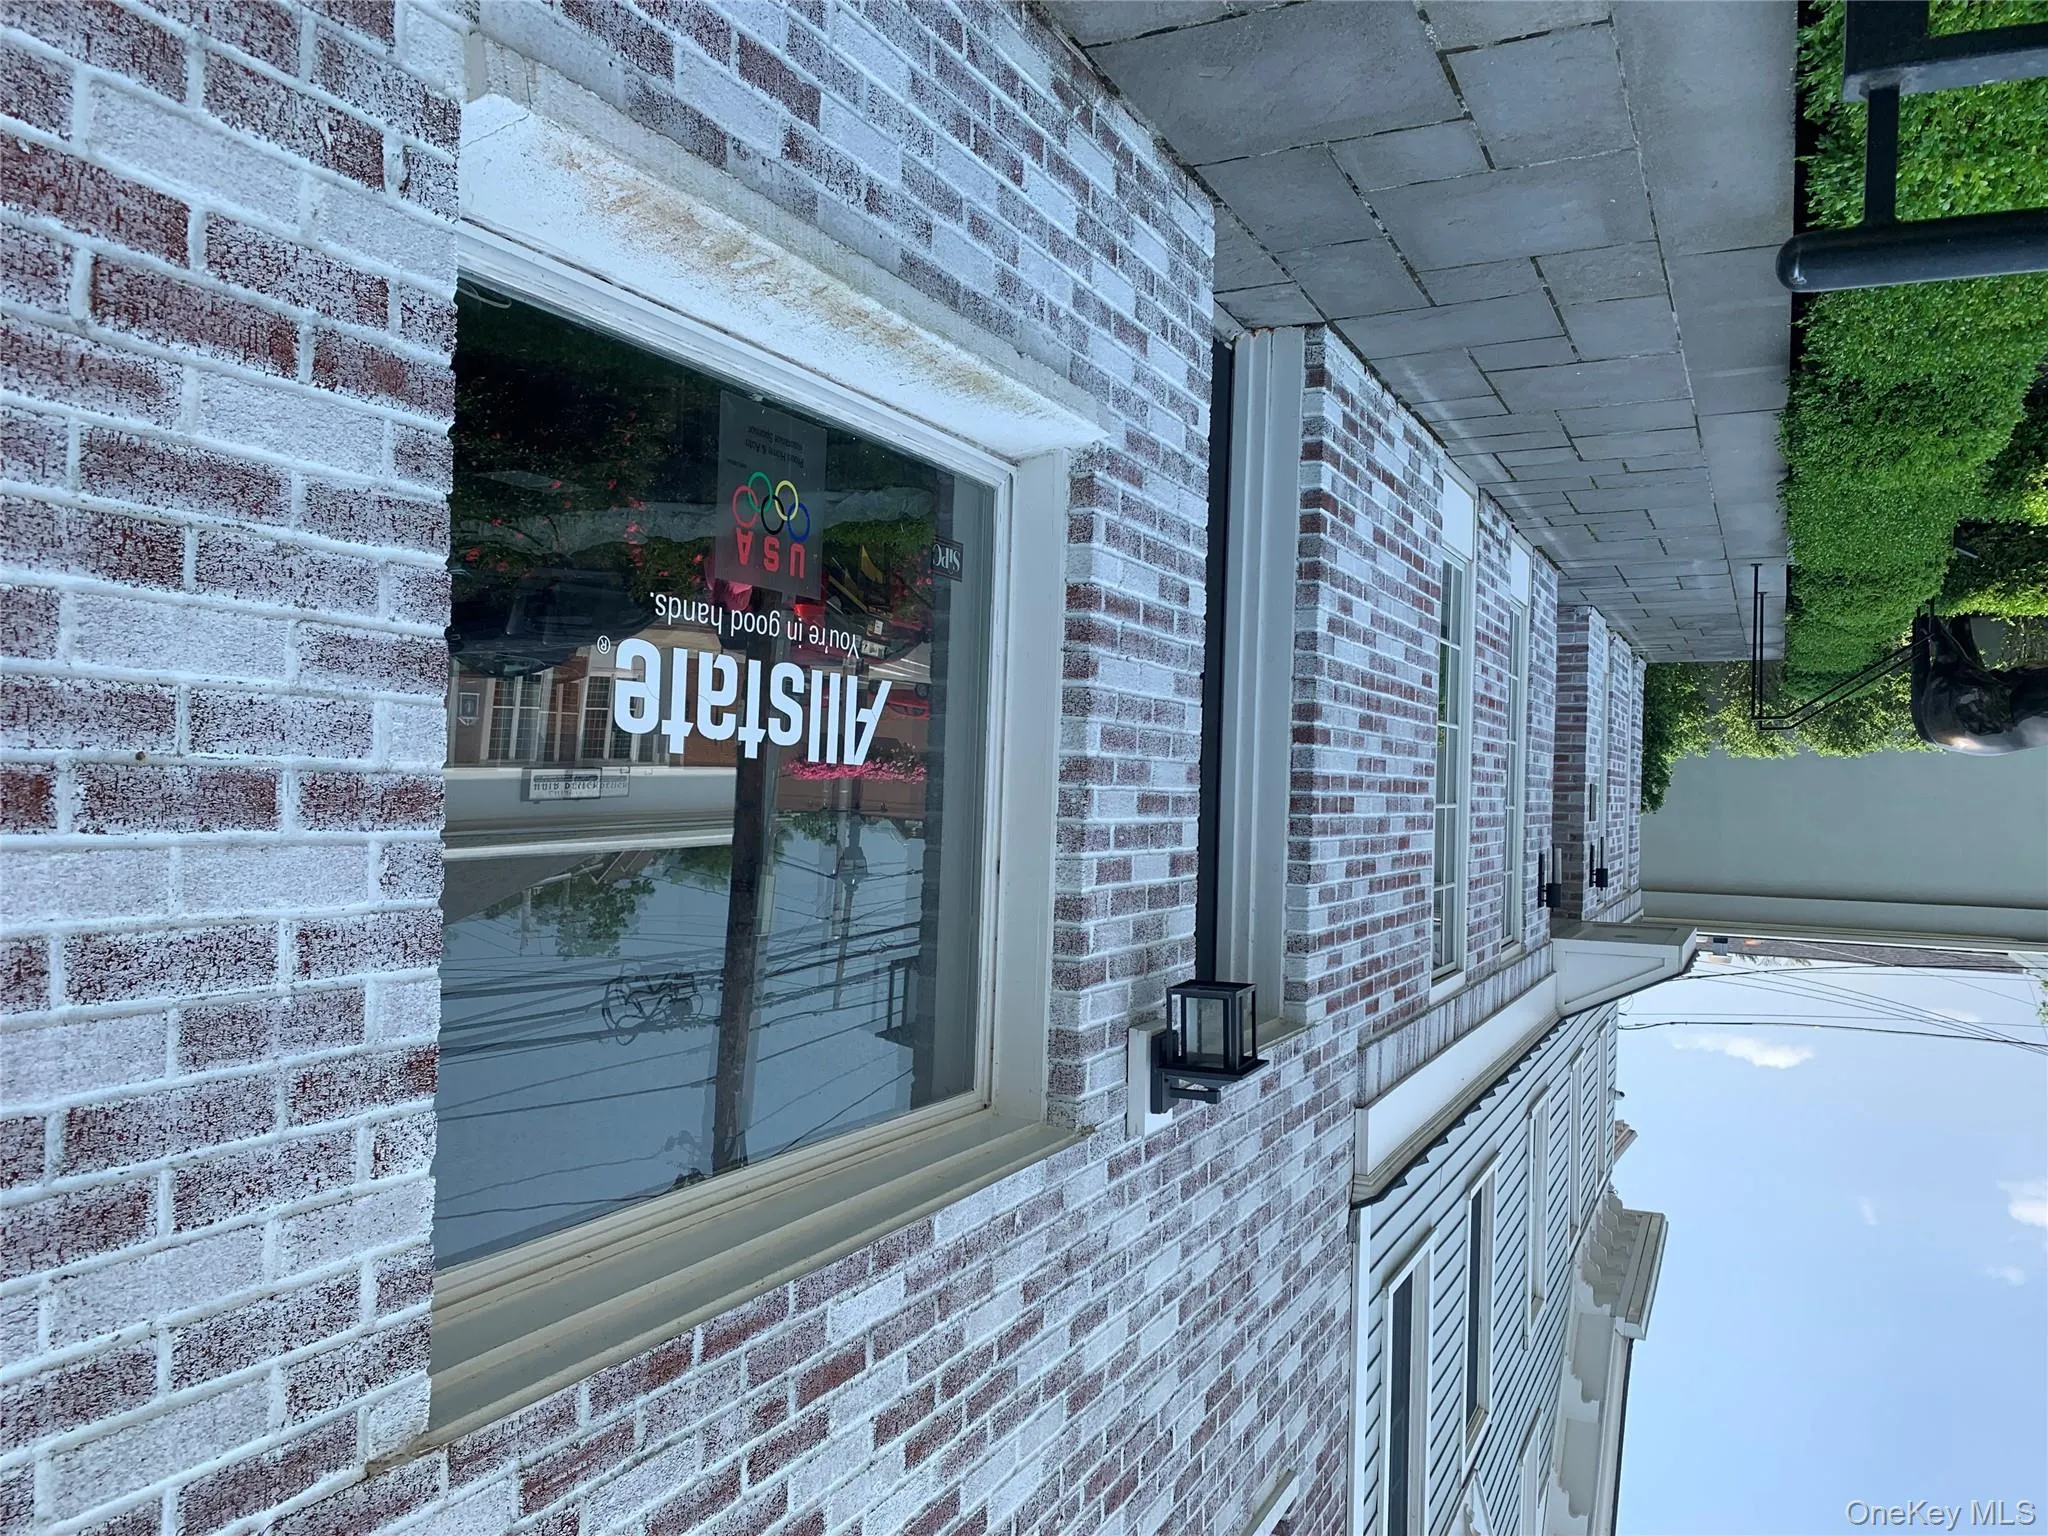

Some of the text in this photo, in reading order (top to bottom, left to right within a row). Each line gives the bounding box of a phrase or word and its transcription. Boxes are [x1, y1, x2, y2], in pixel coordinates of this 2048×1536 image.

[735, 527, 806, 579] USA
[649, 591, 723, 635] hands.
[730, 608, 781, 637] good
[786, 619, 803, 650] in
[808, 624, 861, 660] You're
[613, 637, 893, 767] Allstate
